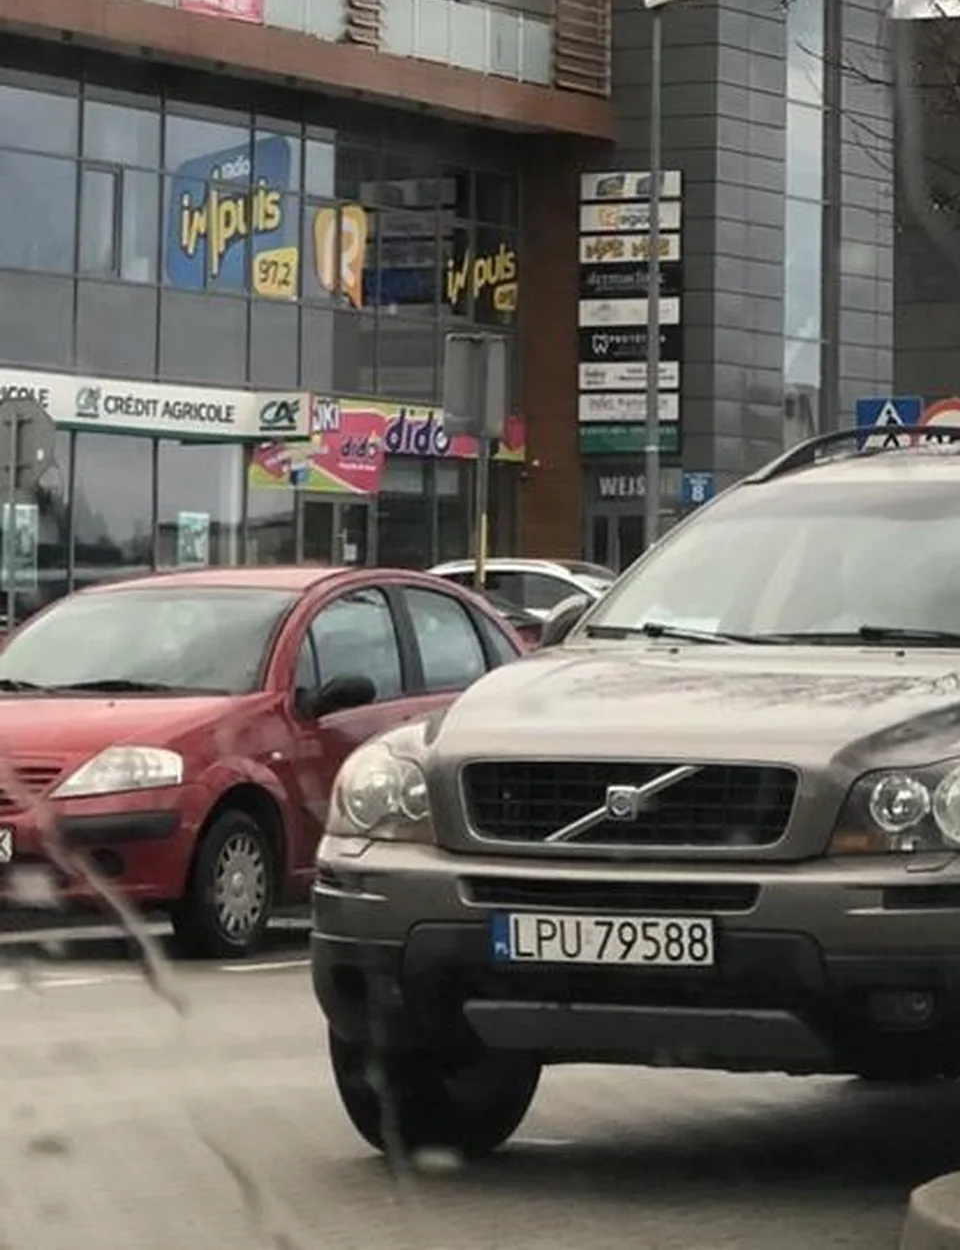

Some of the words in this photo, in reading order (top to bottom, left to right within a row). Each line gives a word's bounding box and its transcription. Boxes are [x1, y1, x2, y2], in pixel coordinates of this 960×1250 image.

[103, 393, 159, 417] CRÉDIT
[161, 401, 235, 423] AGRICOLE
[385, 406, 451, 457] dido
[513, 917, 582, 959] LPU
[594, 920, 709, 962] 79588
